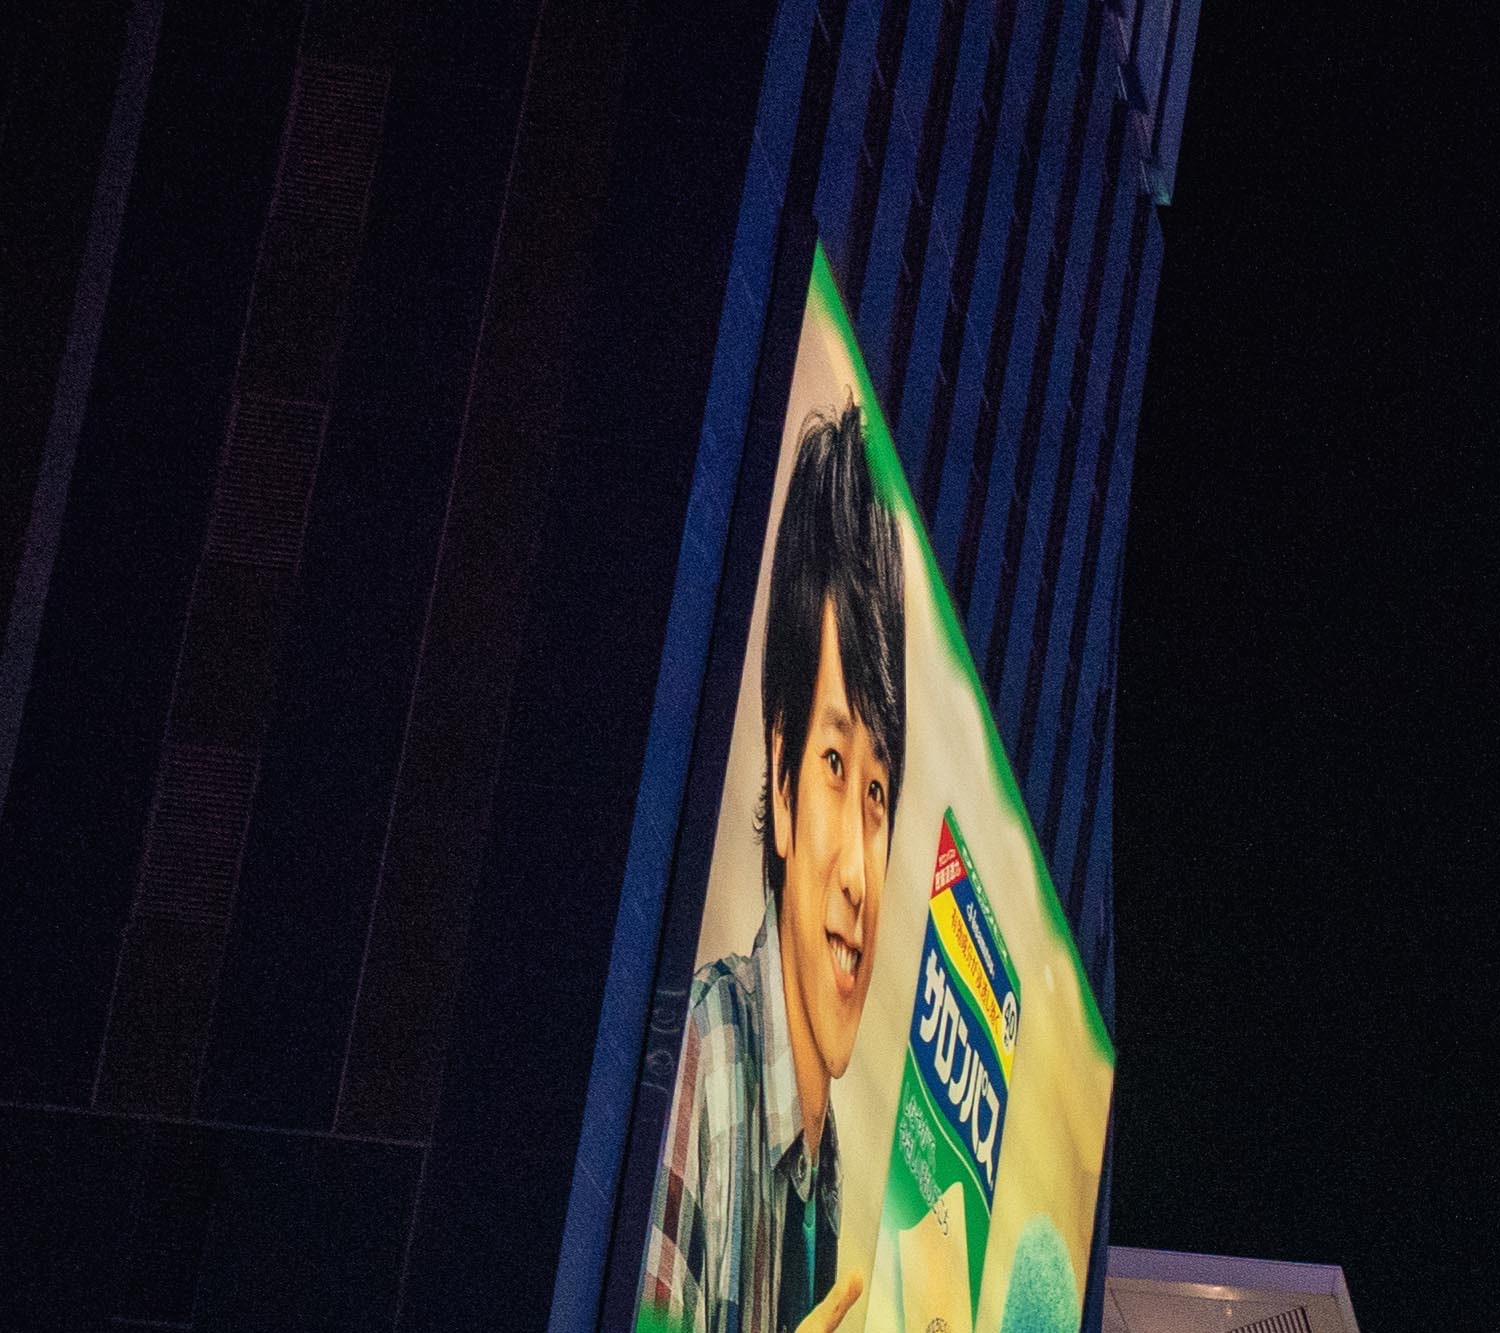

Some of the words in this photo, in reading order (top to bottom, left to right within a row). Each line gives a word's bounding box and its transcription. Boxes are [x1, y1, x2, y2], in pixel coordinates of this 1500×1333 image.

[918, 948, 1000, 1188] サロンパス
